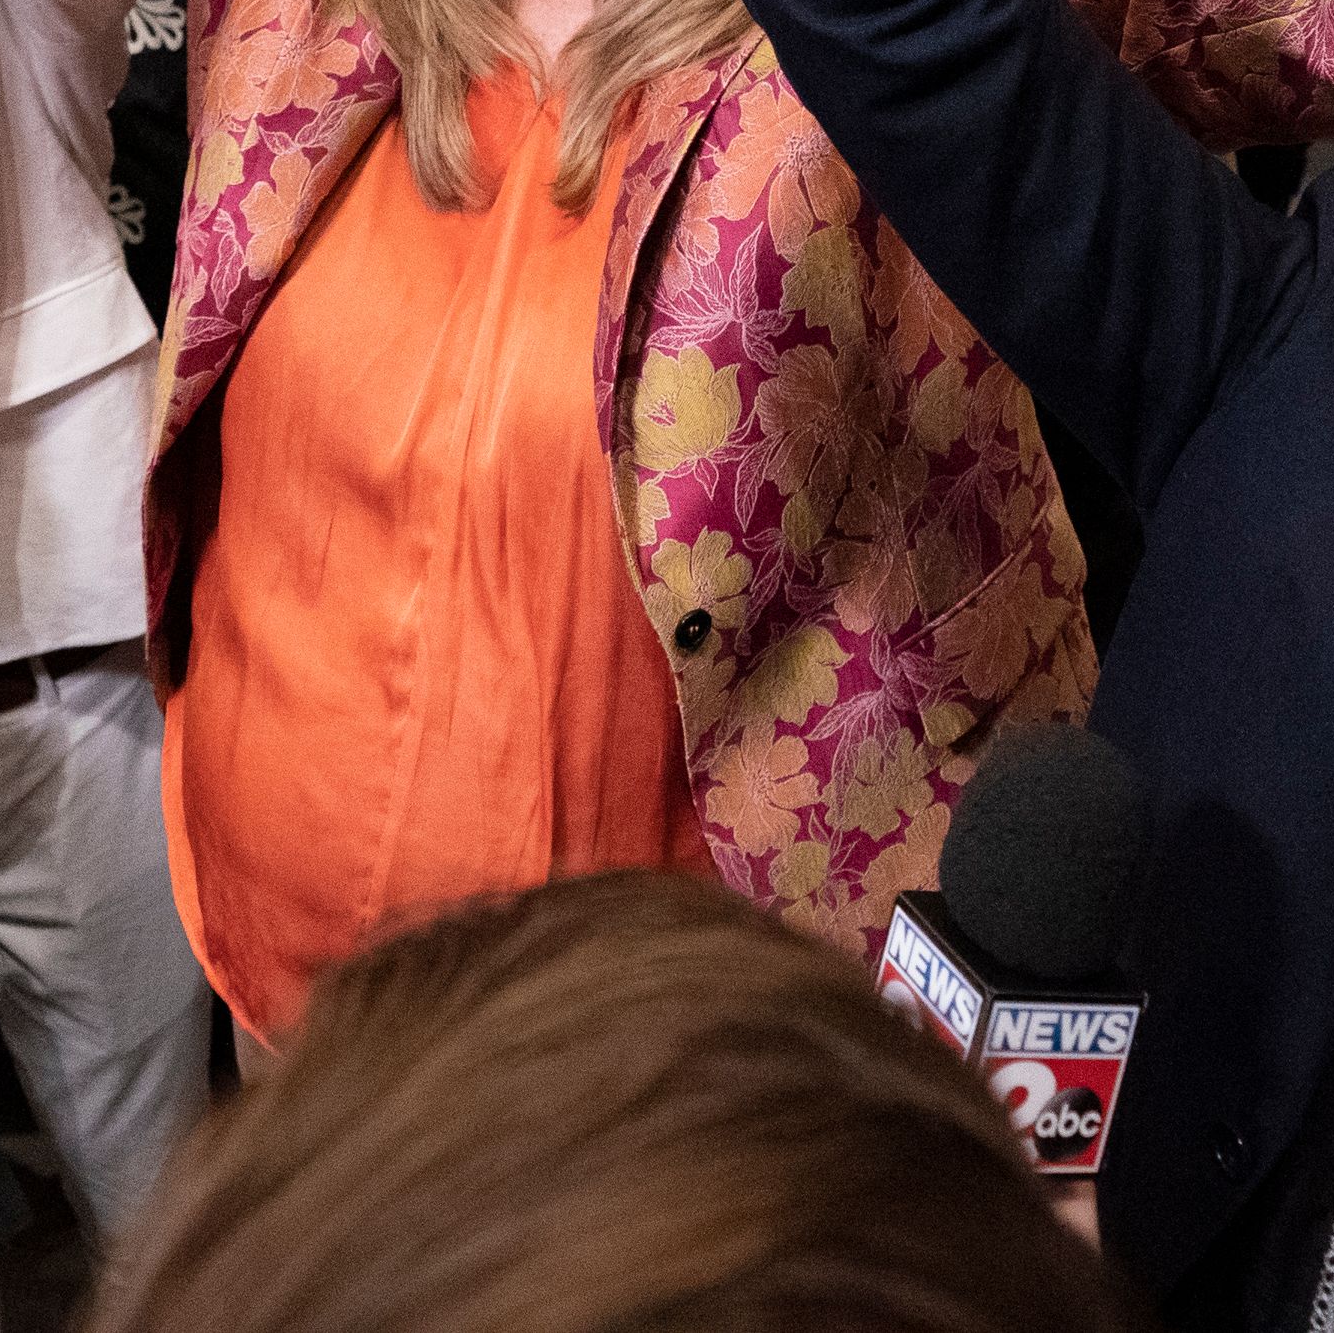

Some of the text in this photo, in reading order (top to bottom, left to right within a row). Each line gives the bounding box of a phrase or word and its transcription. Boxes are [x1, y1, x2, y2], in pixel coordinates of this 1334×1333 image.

[888, 919, 976, 1038] NEWS
[990, 1011, 1129, 1053] NEWS
[1034, 1104, 1101, 1138] abc
